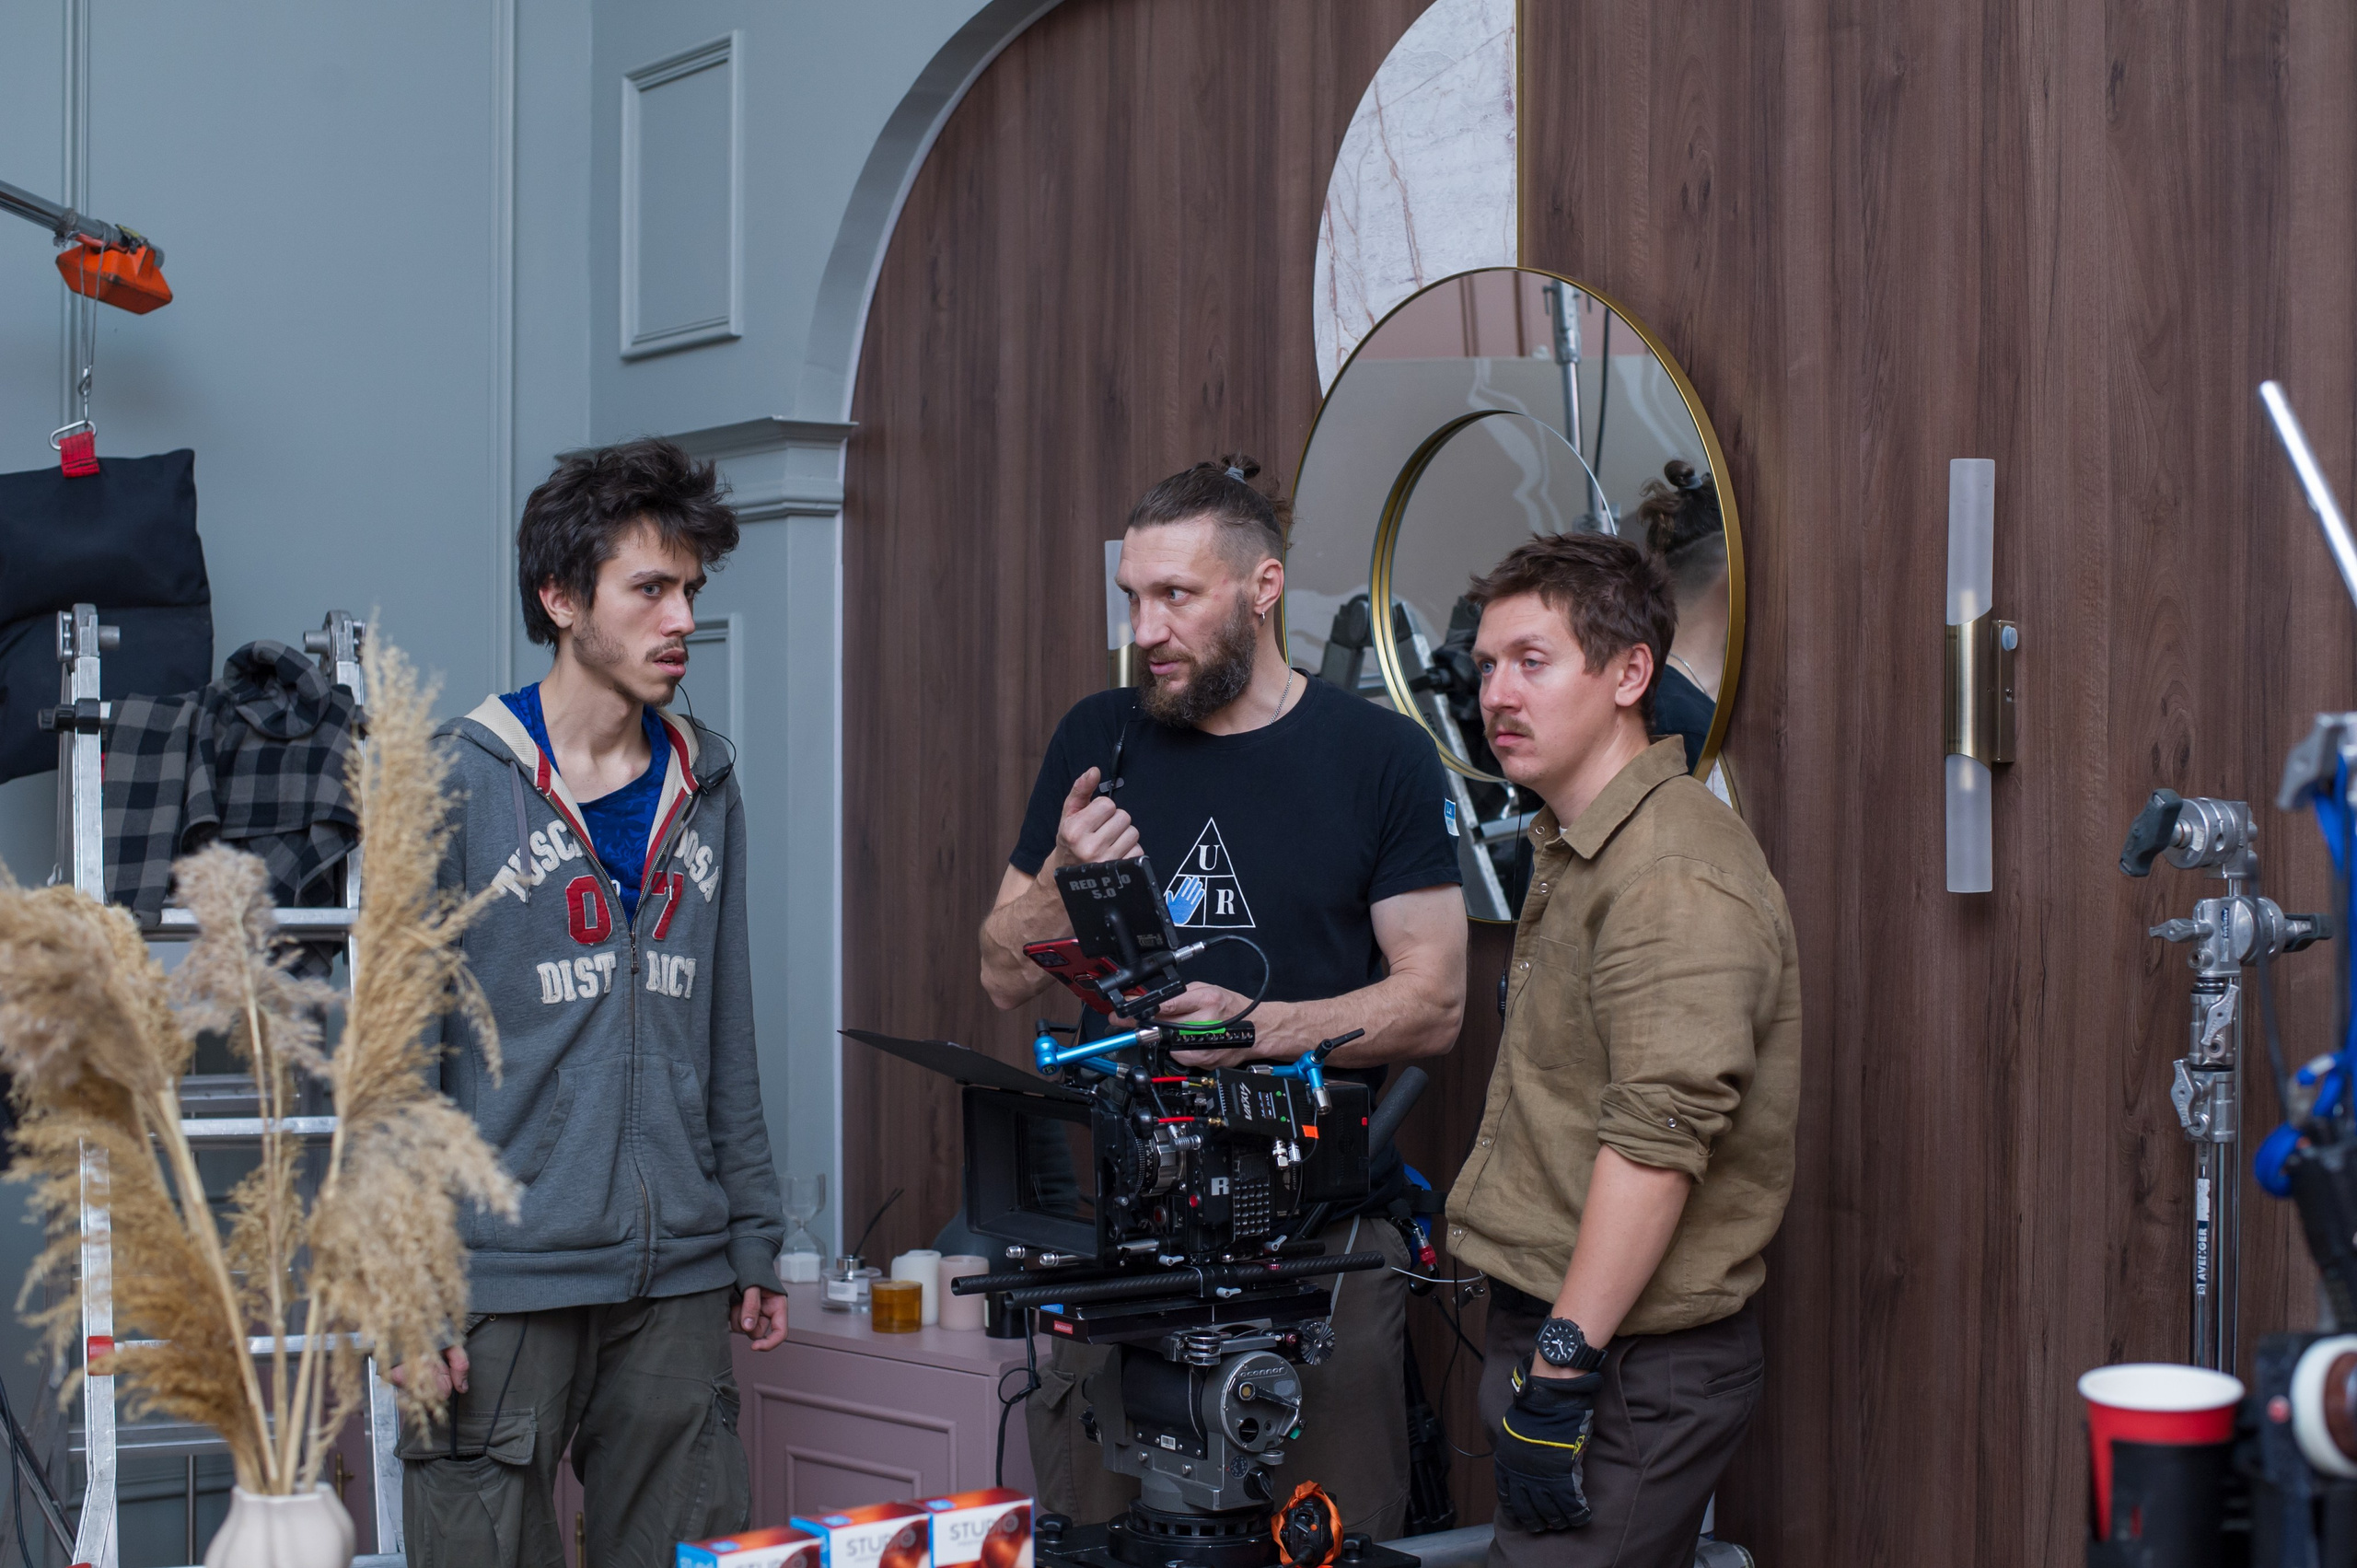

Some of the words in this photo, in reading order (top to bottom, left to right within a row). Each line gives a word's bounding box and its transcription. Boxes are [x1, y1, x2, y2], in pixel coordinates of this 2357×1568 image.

[1198, 844, 1220, 871] U
[1069, 878, 1097, 891] RED
[1101, 874, 1132, 888] PO
[1091, 888, 1117, 900] 5.0
[1214, 889, 1236, 915] R
